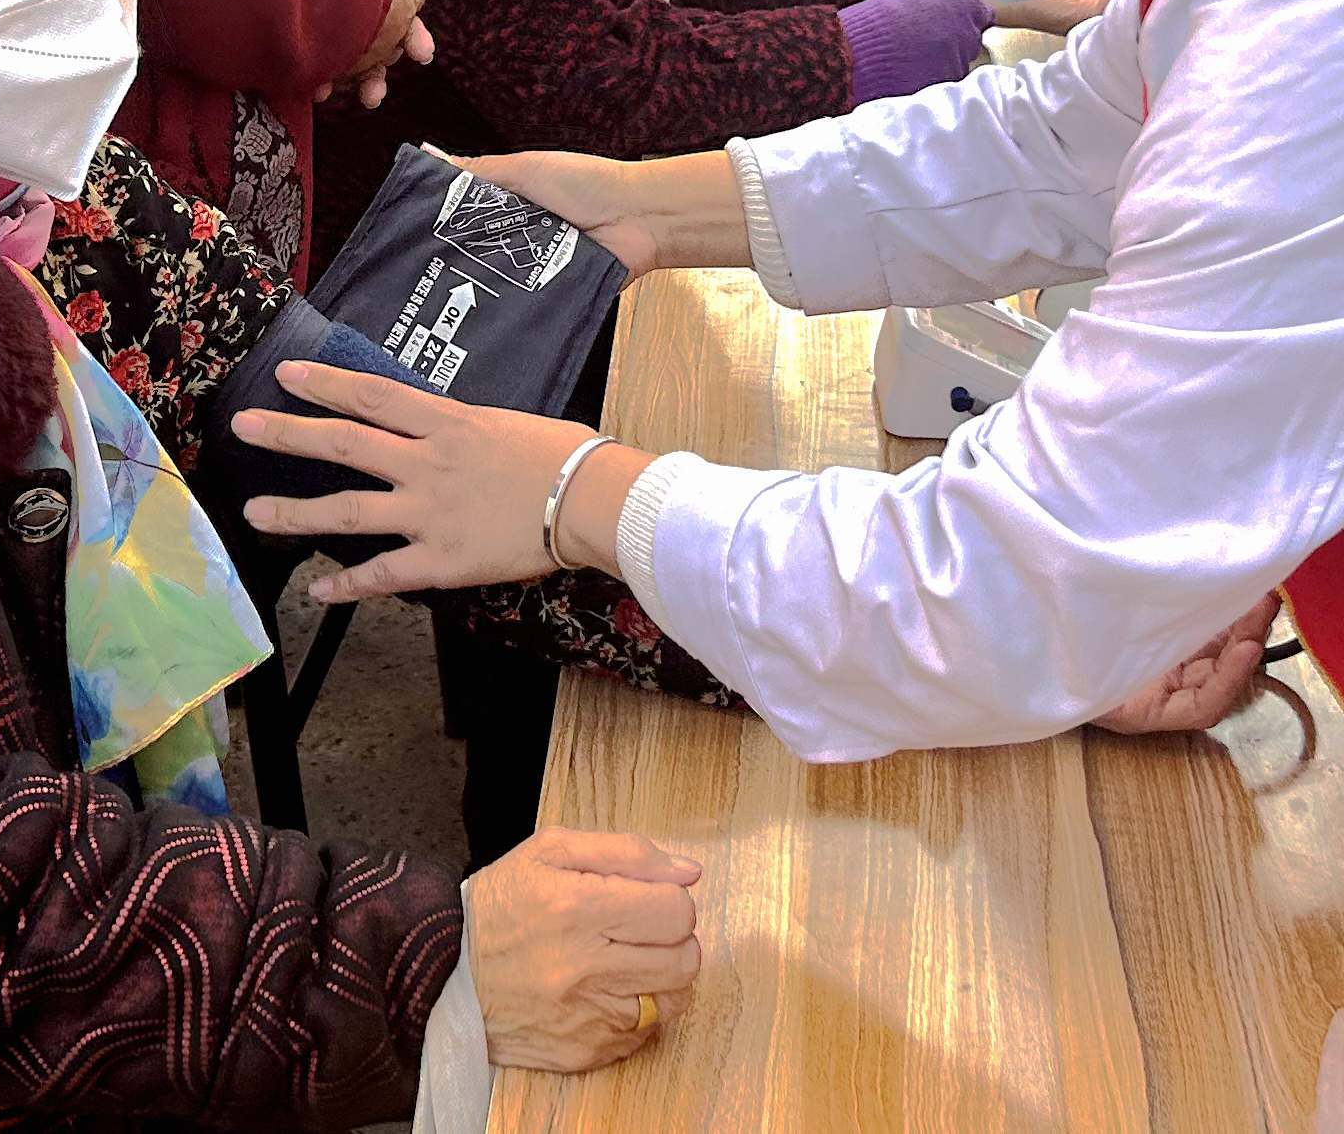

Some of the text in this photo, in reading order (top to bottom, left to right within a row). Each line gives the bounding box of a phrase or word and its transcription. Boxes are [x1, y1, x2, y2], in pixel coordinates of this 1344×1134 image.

[423, 256, 446, 281] CUFF
[524, 264, 543, 288] CUFF
[413, 275, 435, 298] SIZE
[402, 301, 420, 318] OK
[409, 292, 425, 306] IS
[397, 312, 413, 327] IF
[440, 304, 462, 329] OK
[383, 321, 409, 351] METAL
[422, 339, 442, 361] 24
[428, 349, 462, 392] ADULT
